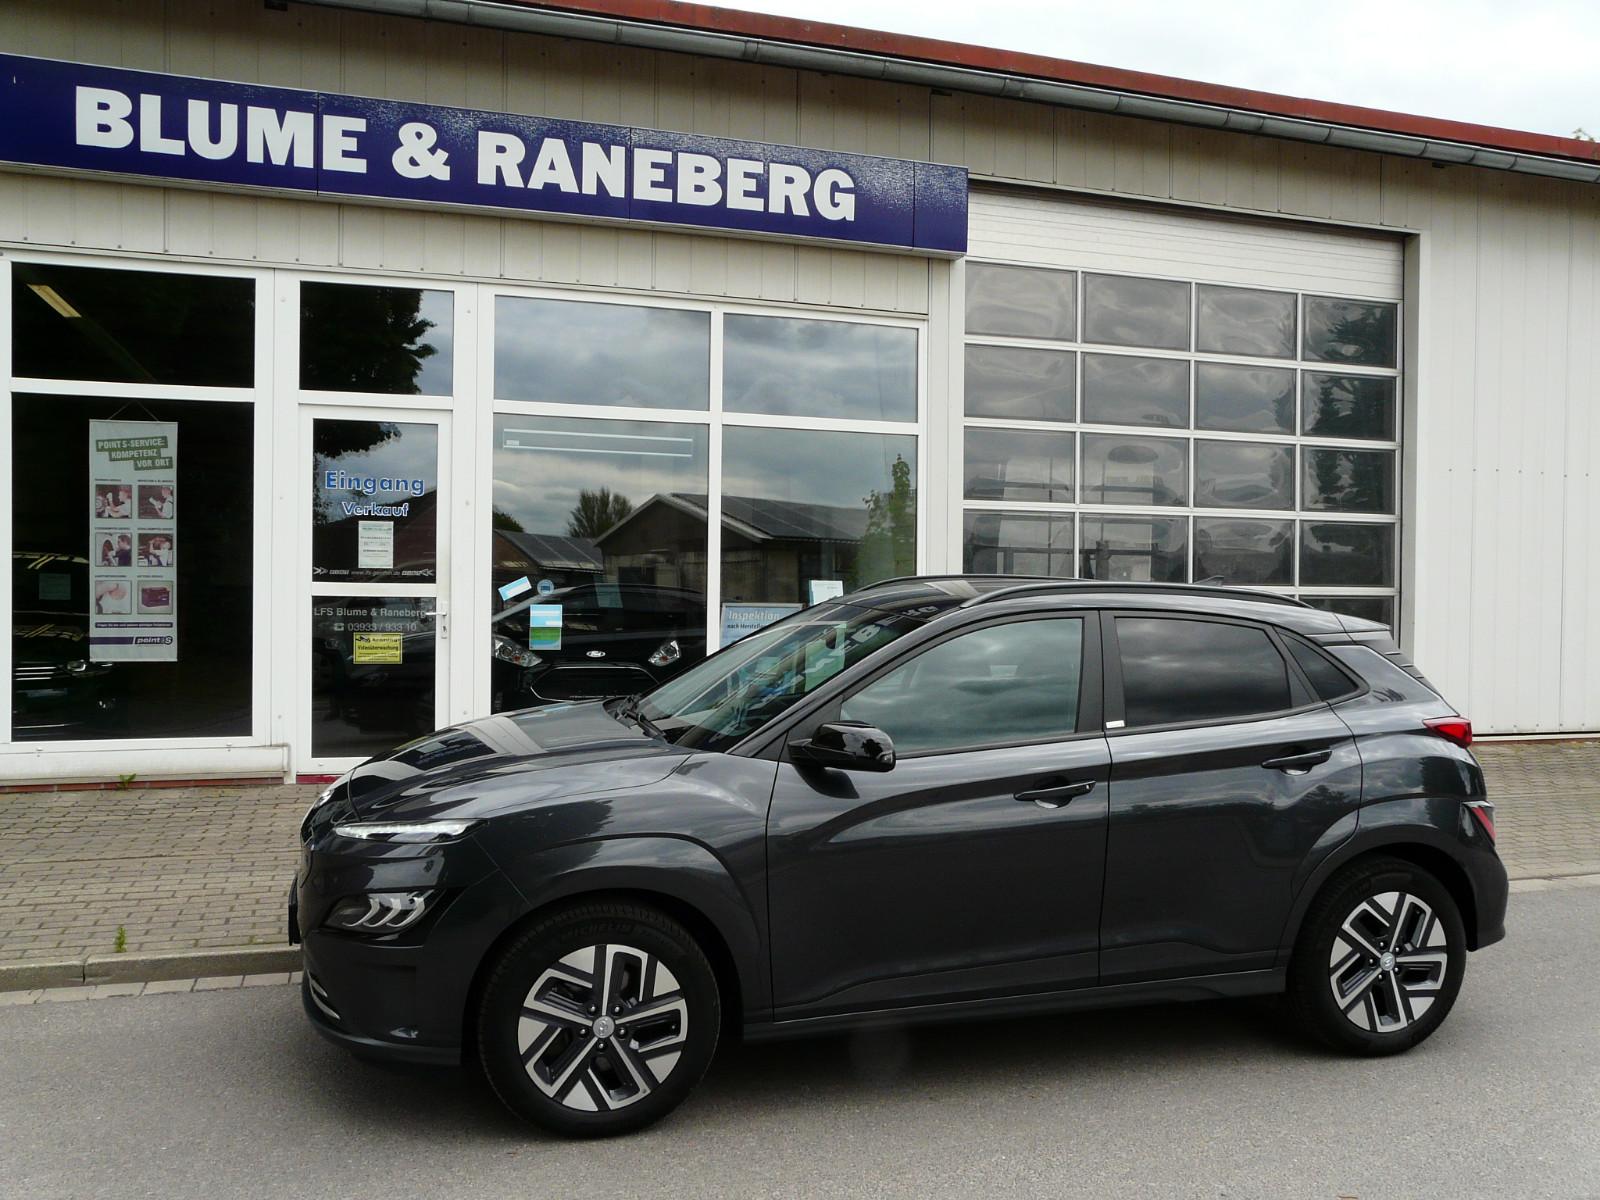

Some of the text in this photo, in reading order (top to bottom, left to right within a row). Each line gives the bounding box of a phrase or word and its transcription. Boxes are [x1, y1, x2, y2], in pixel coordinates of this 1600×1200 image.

[75, 85, 855, 221] BLUME & RANEBERG
[98, 441, 120, 449] POINT
[111, 449, 158, 458] KOMPETENZ
[136, 458, 170, 468] VOR ORT
[325, 470, 425, 497] Eingang
[341, 501, 409, 517] Verkauf
[314, 607, 426, 618] LFS Blume & Raneberg
[728, 610, 780, 621] Inspektion
[347, 623, 377, 631] 03933
[137, 636, 160, 644] point
